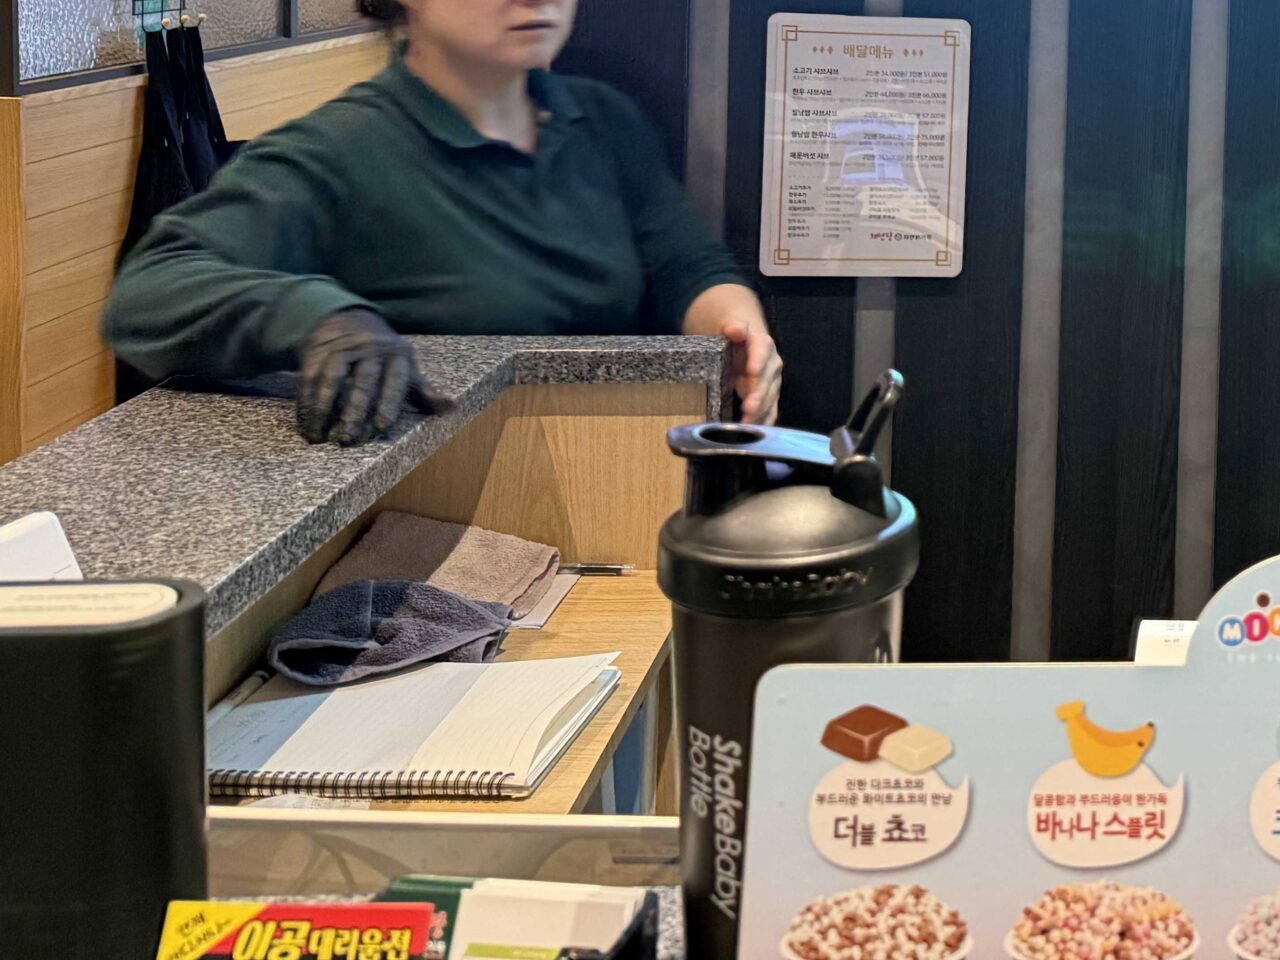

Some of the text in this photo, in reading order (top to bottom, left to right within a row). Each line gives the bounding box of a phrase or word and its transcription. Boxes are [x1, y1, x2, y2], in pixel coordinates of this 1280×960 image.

[843, 44, 894, 58] 배달메뉴
[689, 725, 713, 819] Bottle
[846, 778, 867, 790] 진한
[816, 793, 859, 806] 부드러운
[931, 793, 952, 805] 만남
[1034, 793, 1076, 806] 달콤함과
[1136, 793, 1168, 805] 한가득
[833, 814, 876, 848] 더블
[1036, 809, 1166, 841] 바나나 스플릿
